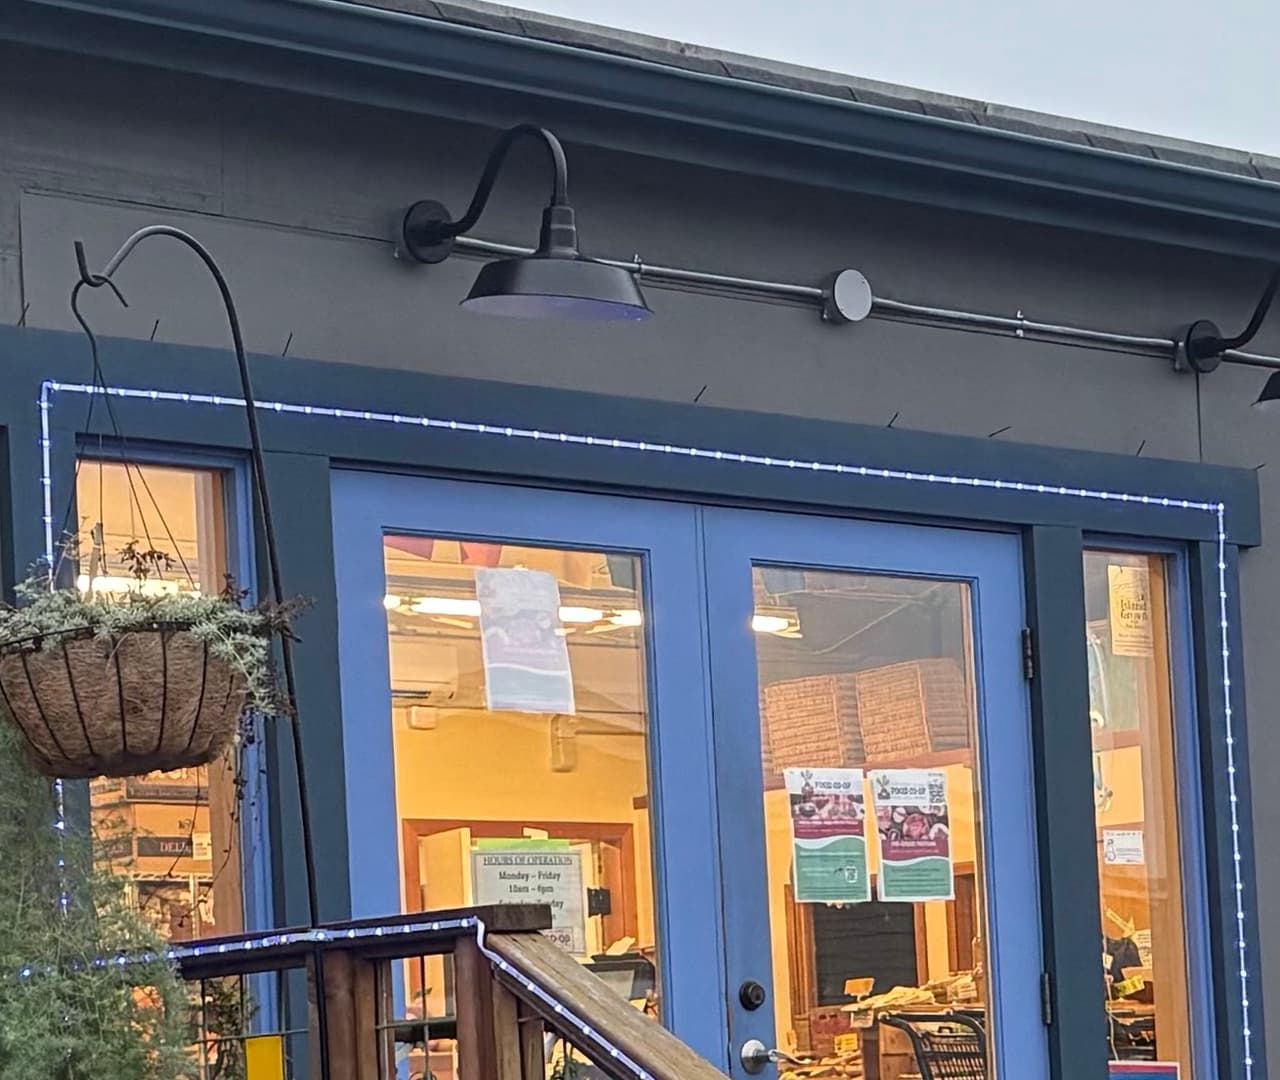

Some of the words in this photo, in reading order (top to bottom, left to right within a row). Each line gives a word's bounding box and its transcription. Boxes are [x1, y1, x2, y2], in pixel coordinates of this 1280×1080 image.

[484, 855, 512, 866] HOURS
[515, 855, 526, 866] OF
[527, 855, 573, 866] OPERATION
[499, 871, 529, 883] Monday
[538, 871, 561, 882] Friday
